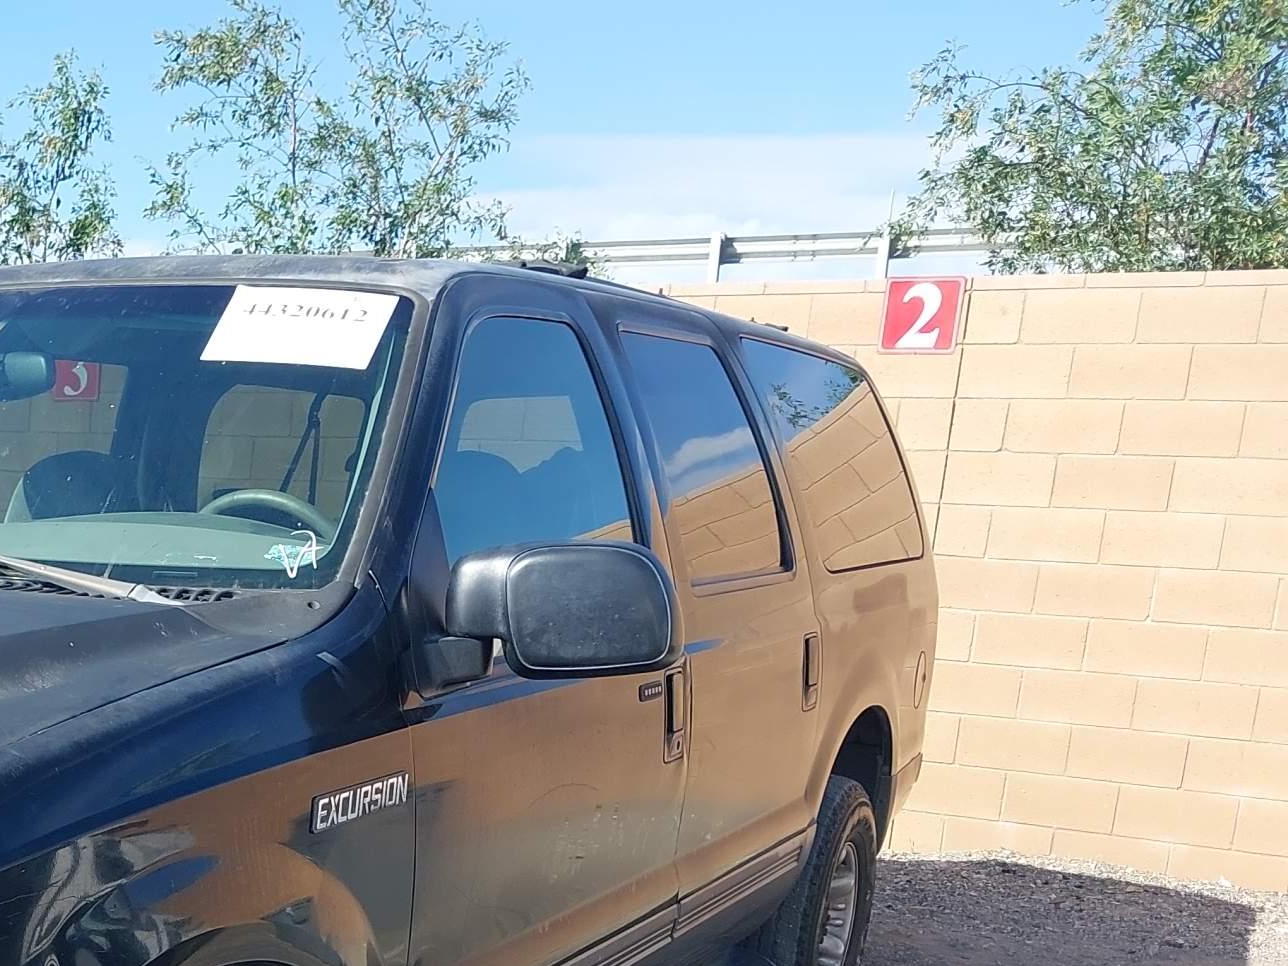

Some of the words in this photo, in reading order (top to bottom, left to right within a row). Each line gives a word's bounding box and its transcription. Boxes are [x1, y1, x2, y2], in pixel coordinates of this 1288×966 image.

[243, 303, 368, 322] 44320612
[894, 282, 943, 349] 2
[317, 773, 409, 830] EXCURSION
